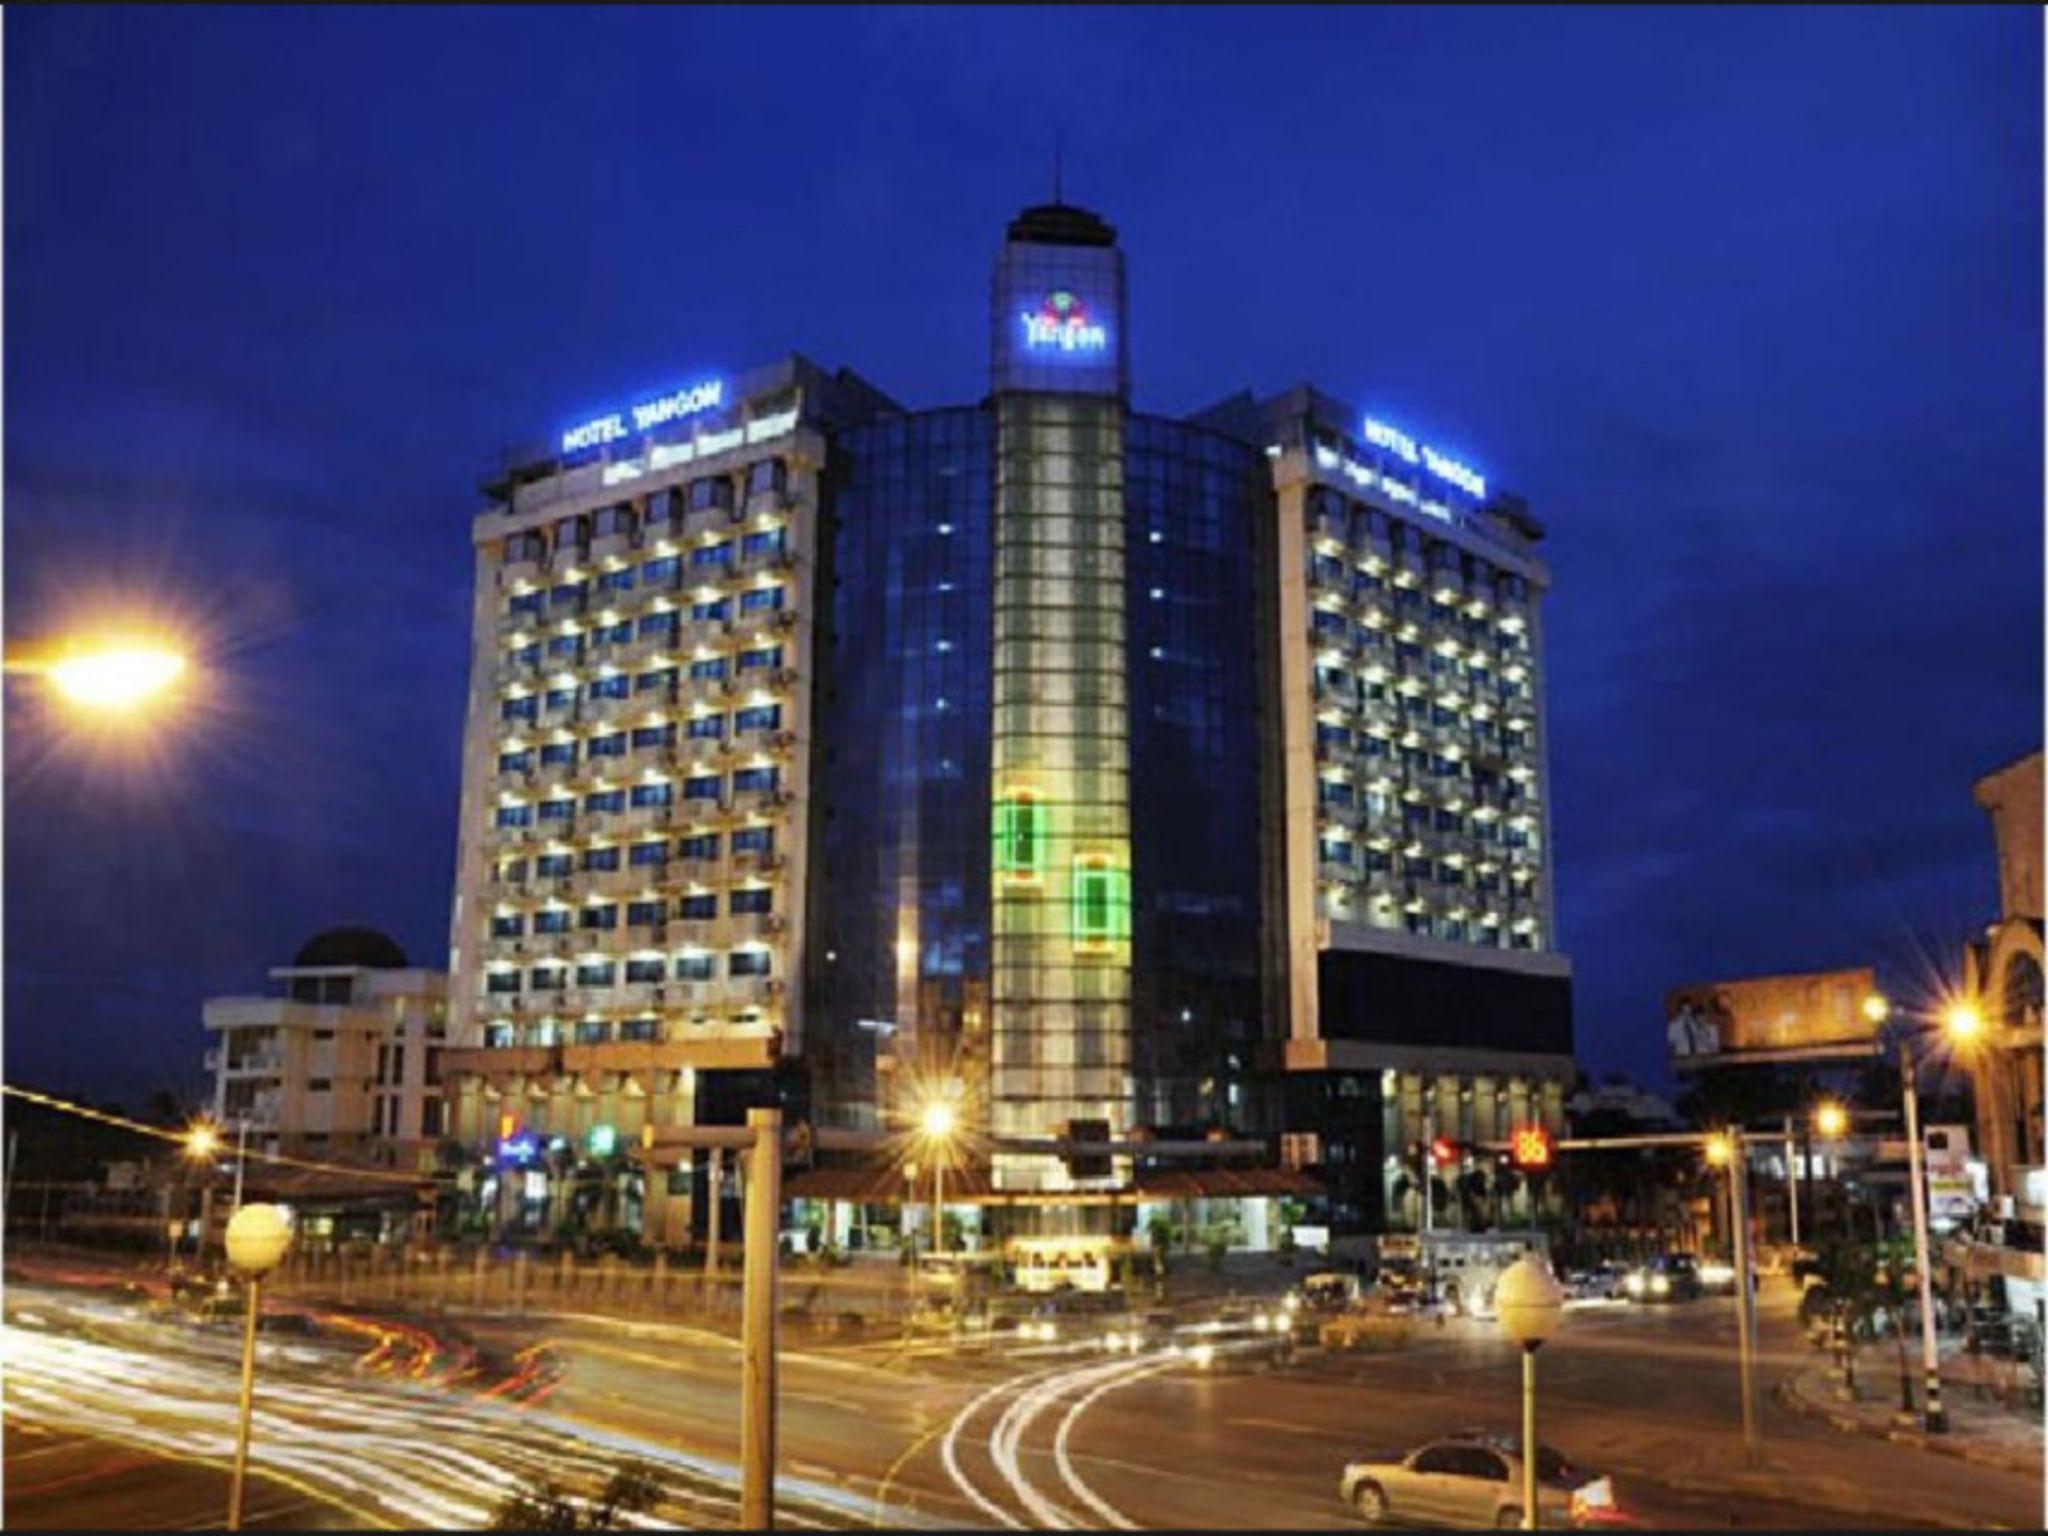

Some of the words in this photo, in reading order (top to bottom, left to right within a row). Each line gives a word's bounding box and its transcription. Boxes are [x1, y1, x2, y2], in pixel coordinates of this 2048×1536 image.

[562, 414, 628, 453] HOTEL
[632, 380, 722, 430] YANGON
[1364, 416, 1420, 463] HOTEL
